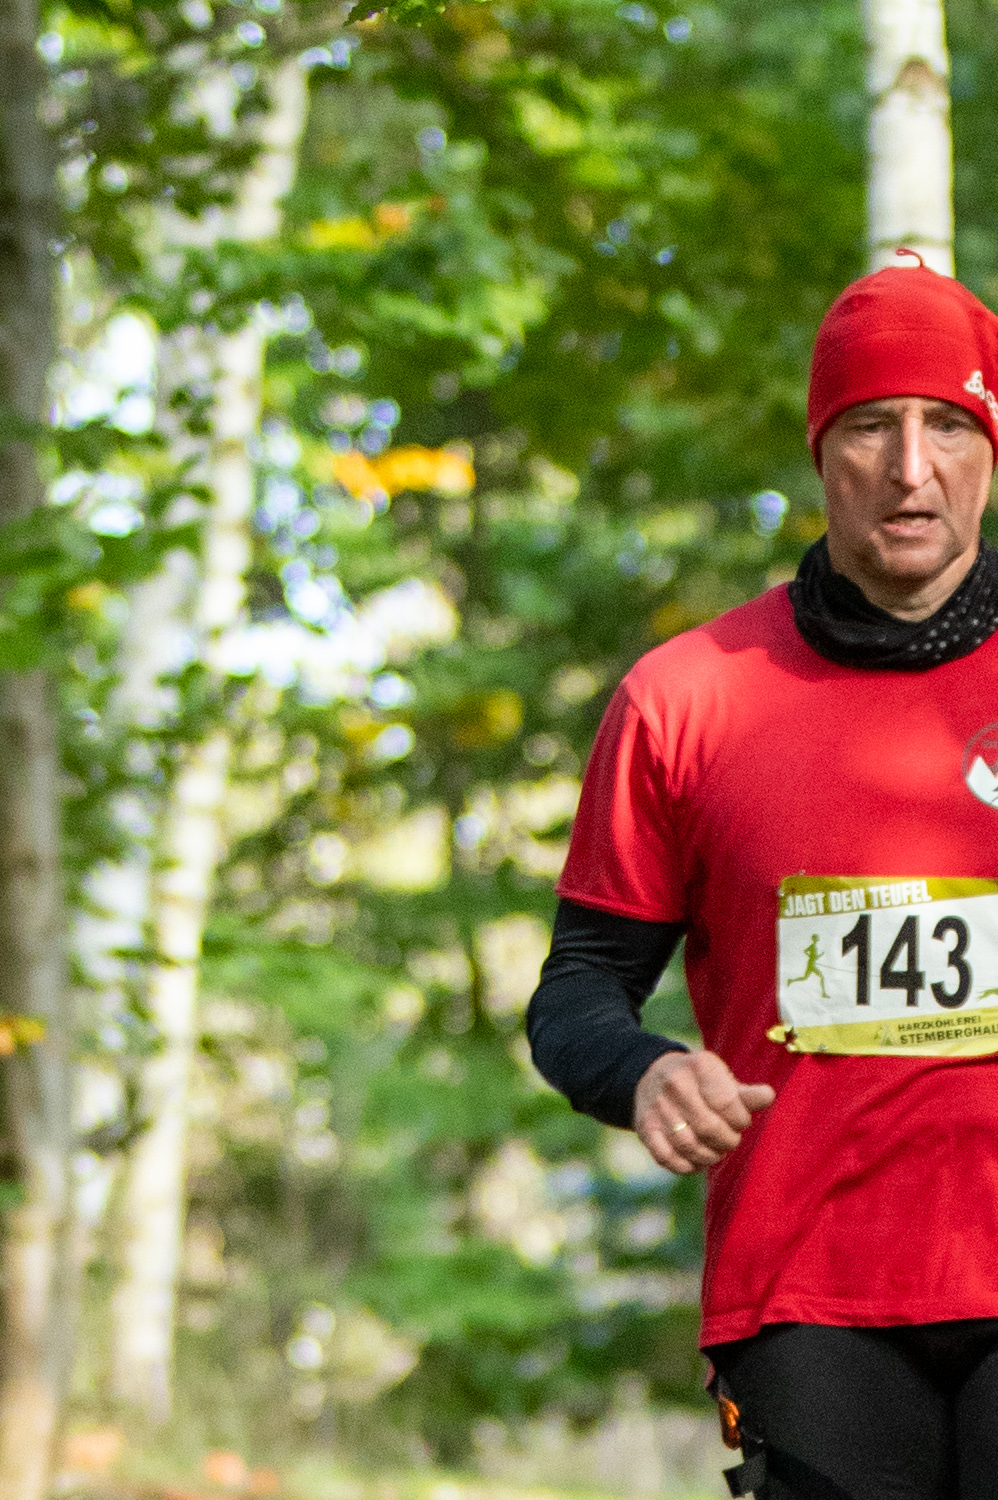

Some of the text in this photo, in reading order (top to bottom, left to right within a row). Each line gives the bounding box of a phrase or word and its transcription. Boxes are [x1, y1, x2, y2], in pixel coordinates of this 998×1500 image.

[784, 880, 932, 916] JAGT DEN TEUFEL
[841, 914, 972, 1009] 143
